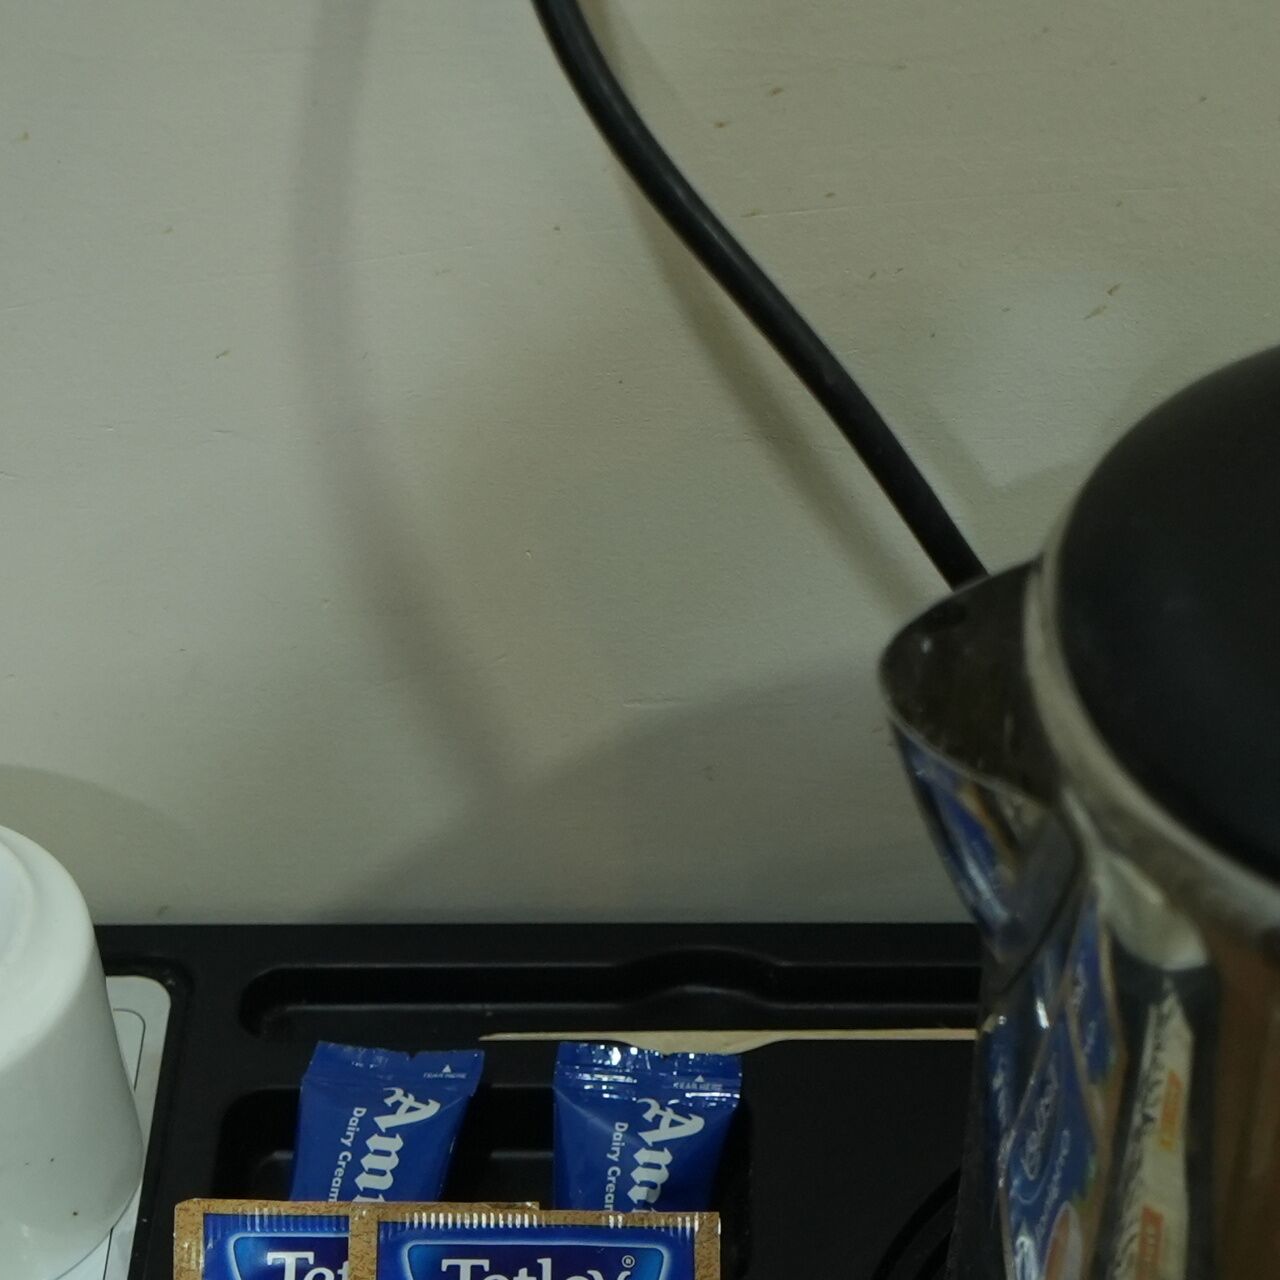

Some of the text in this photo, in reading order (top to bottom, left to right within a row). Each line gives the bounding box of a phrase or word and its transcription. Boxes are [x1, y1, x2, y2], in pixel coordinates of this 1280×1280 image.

[340, 1107, 367, 1147] Dairy
[352, 1087, 441, 1202] Am
[607, 1121, 629, 1162] Dairy
[627, 1098, 705, 1212] Am
